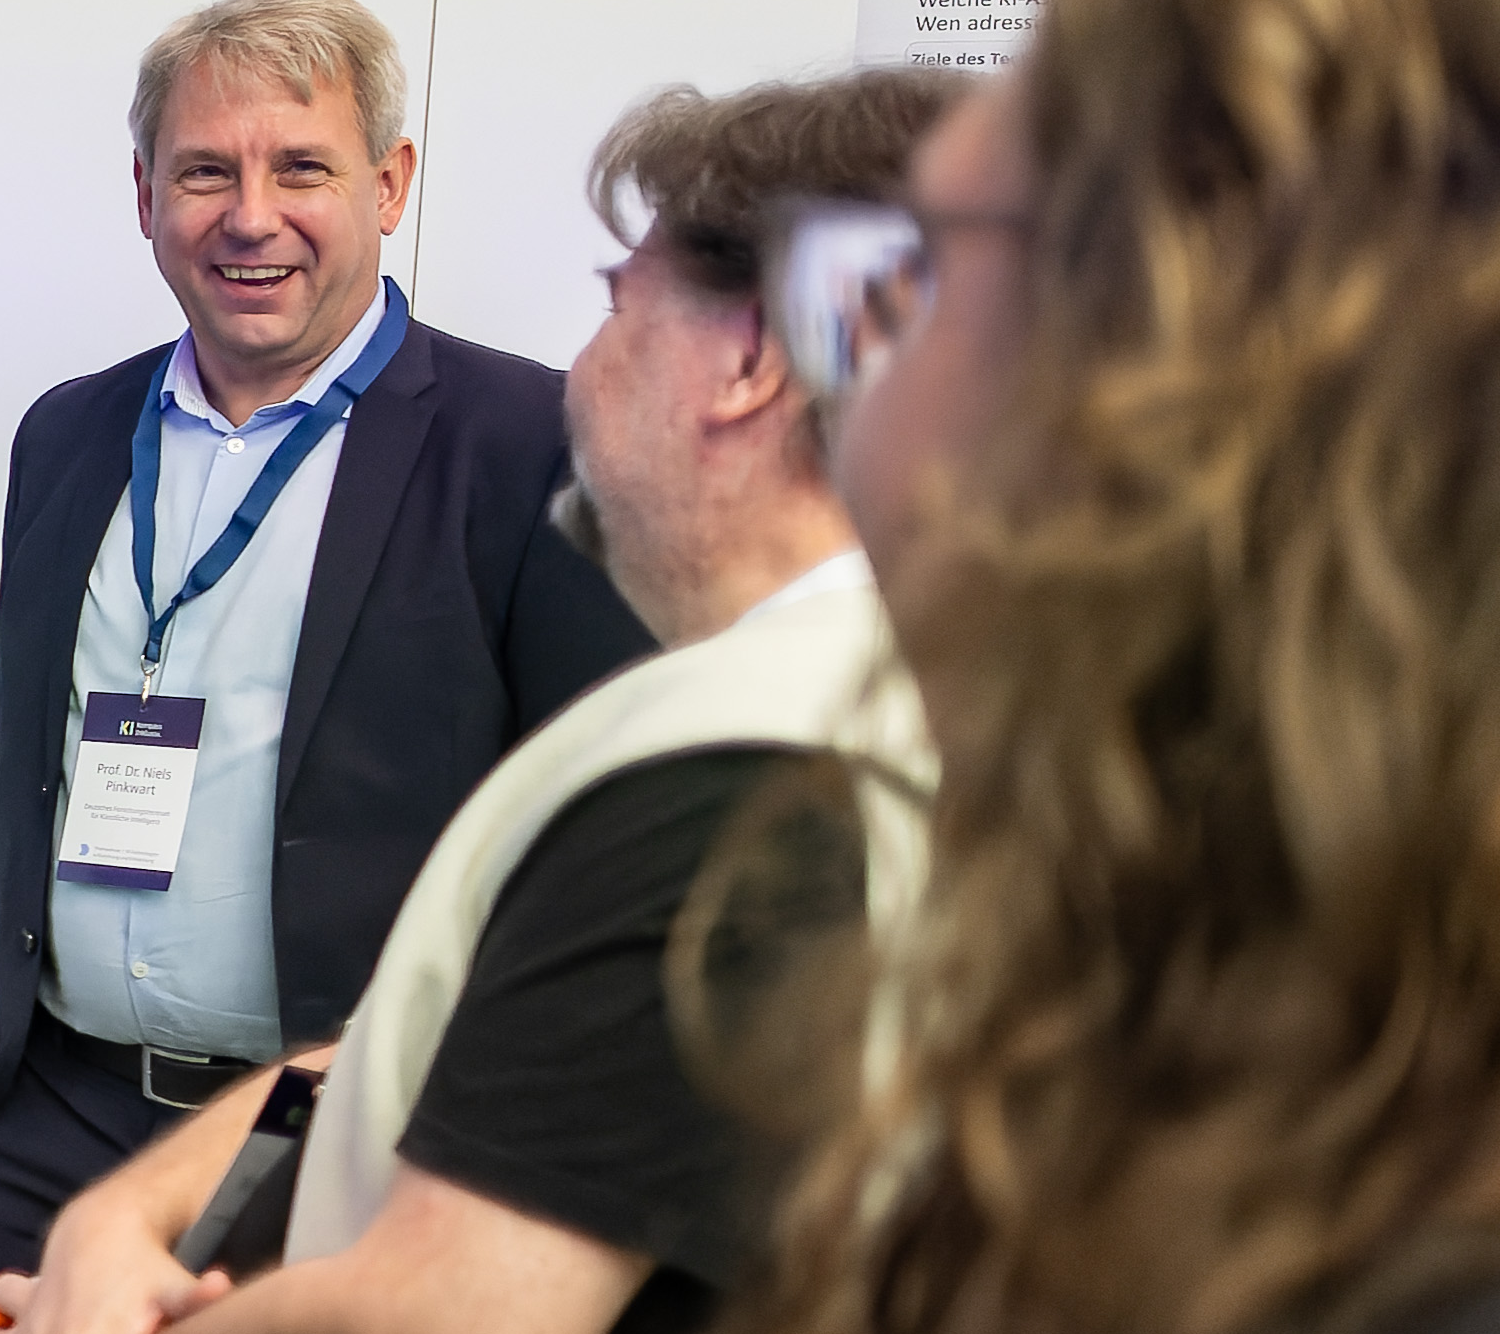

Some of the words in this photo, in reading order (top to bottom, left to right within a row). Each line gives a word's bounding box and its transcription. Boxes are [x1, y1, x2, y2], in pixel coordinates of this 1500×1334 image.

[915, 15, 960, 32] Wen
[911, 52, 951, 67] Ziele
[956, 52, 986, 66] des
[143, 767, 172, 781] Niels
[105, 780, 156, 796] Pinkwart
